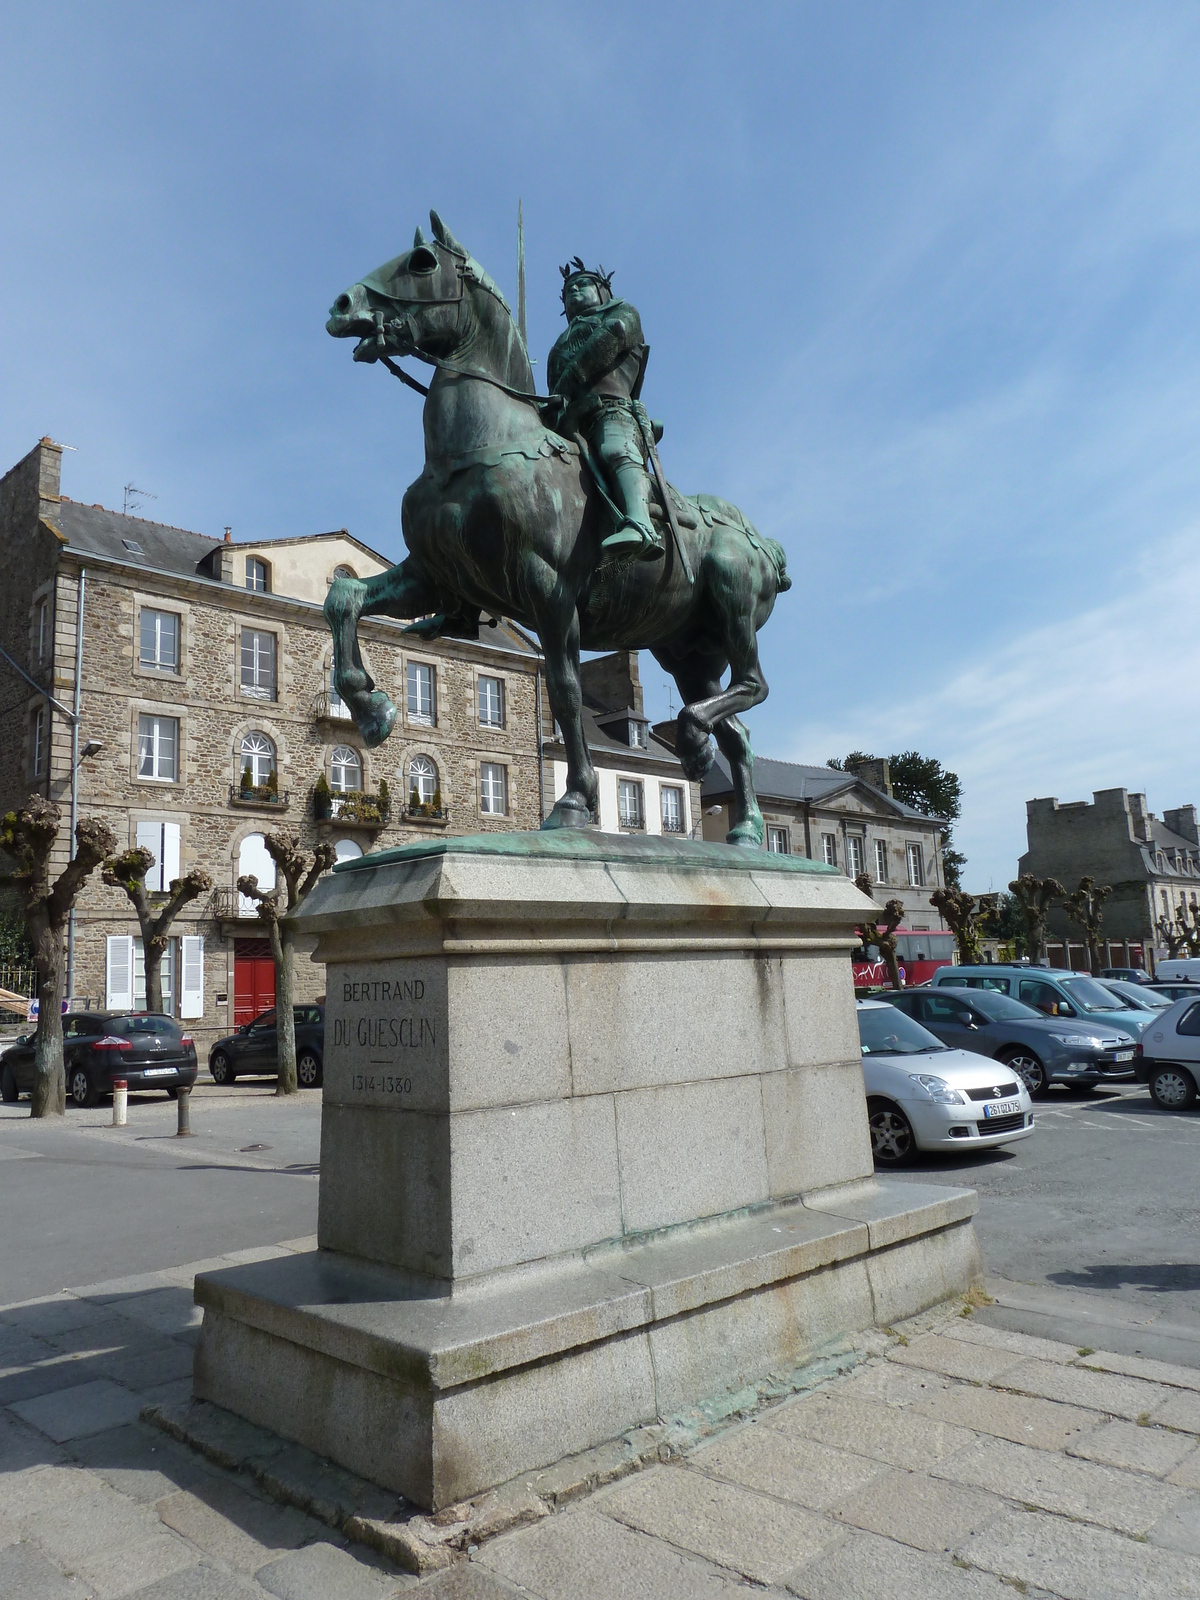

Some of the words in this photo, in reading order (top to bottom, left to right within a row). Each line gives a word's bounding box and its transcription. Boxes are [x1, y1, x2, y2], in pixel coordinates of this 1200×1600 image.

[343, 980, 424, 1001] BERTRAND
[334, 1018, 351, 1046] DU
[357, 1018, 436, 1047] GUESCLIN
[352, 1075, 412, 1093] 1314-1380
